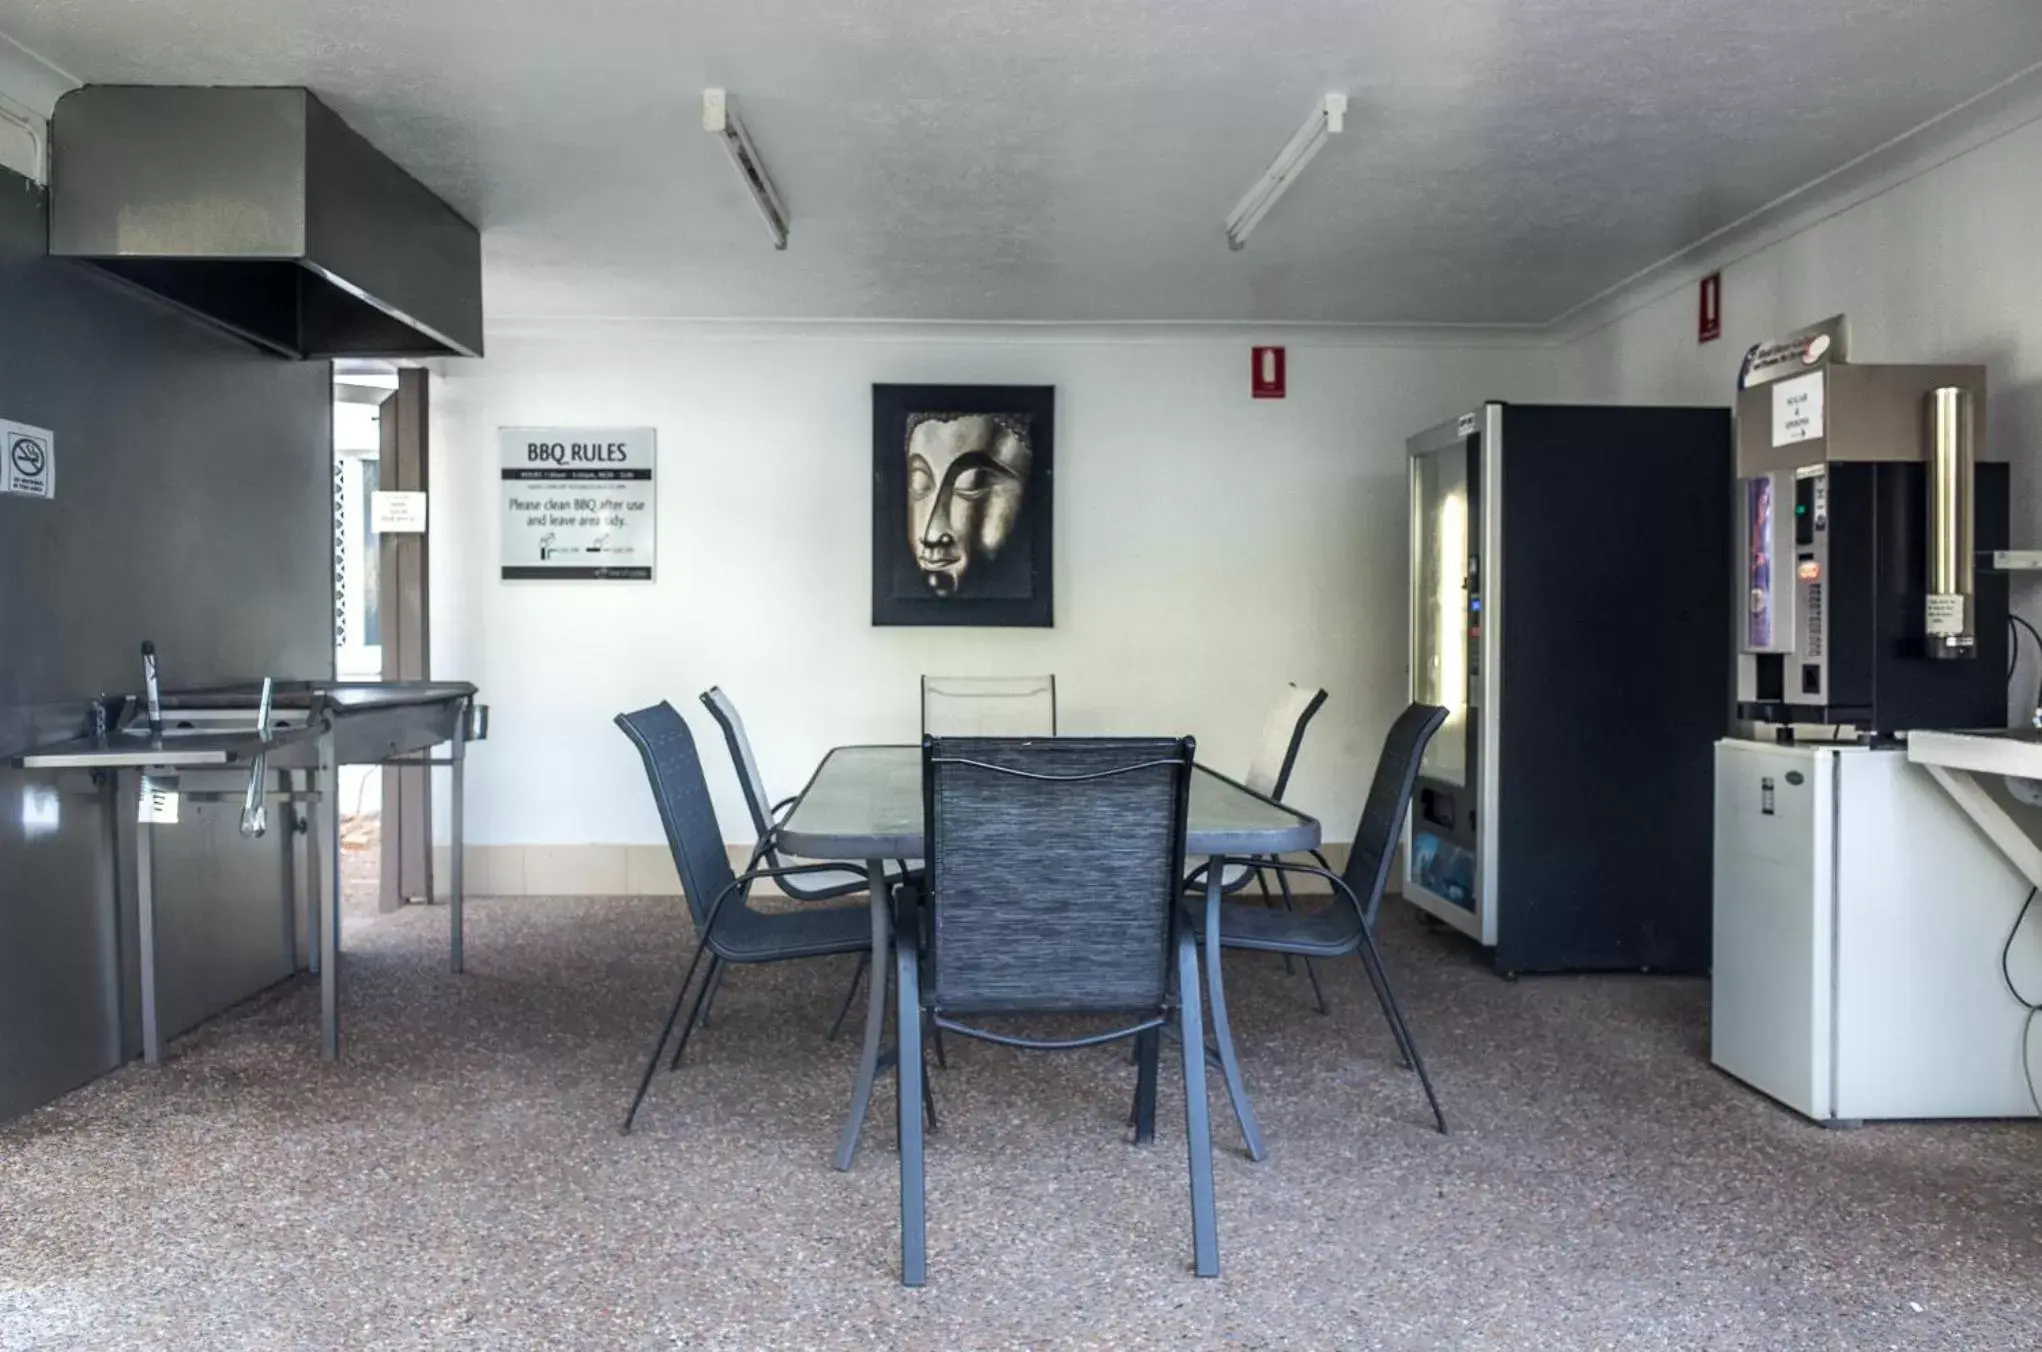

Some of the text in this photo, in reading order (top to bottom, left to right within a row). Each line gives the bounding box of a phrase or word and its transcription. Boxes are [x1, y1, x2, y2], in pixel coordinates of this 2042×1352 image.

[527, 443, 627, 465] BBQ RULES
[509, 499, 646, 512] Please clean BBQ after use
[526, 515, 546, 526] and
[549, 515, 576, 526] leave
[579, 517, 601, 526] area
